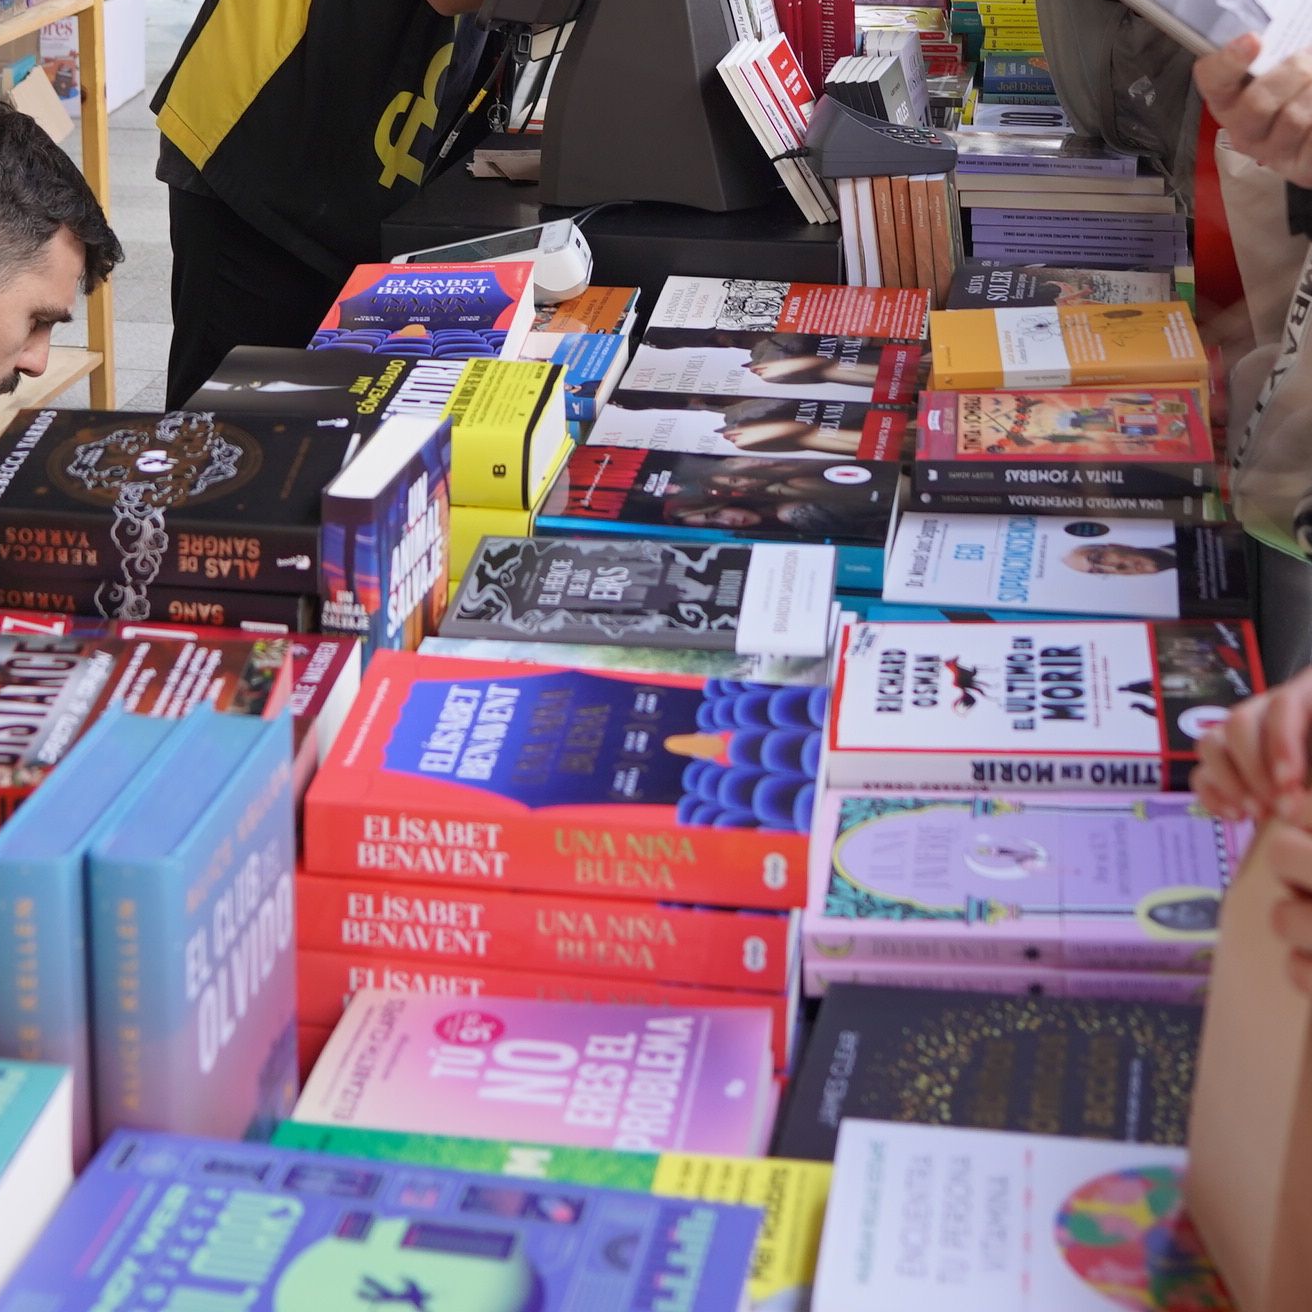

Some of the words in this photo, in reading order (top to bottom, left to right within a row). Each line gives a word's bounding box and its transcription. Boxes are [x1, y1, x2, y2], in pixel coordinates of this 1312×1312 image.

[376, 286, 491, 296] BENAVENT
[385, 277, 489, 288] ELÍSABET
[986, 270, 1014, 302] SOLER
[815, 337, 839, 359] JUAN
[841, 337, 863, 353] VAL
[838, 352, 859, 371] DEL
[348, 375, 374, 396] JUAN
[356, 359, 407, 415] GÓMEZ-JURADO
[794, 401, 819, 425] JUAN
[821, 402, 846, 420] VAL
[20, 409, 59, 454] YARROS
[816, 419, 840, 438] DEL
[1004, 468, 1070, 484] SOMBRAS
[1084, 469, 1125, 484] TINTA
[1008, 494, 1084, 509] ENVENENADA
[1087, 496, 1138, 510] NAVIDAD
[1138, 498, 1165, 511] UNA
[5, 526, 90, 548] YARROS
[176, 533, 261, 556] SANGRE
[178, 554, 199, 573] DE
[952, 542, 986, 563] EGO
[204, 555, 261, 579] ALAS
[322, 599, 368, 615] ANIMAL
[321, 612, 371, 631] SALVAJE
[1012, 635, 1034, 653] EN
[874, 646, 909, 715] RICHARD
[911, 654, 942, 709] OSMAN
[1040, 644, 1087, 723] MORIR
[455, 682, 522, 781] BENAVENT
[1012, 715, 1036, 733] EL
[971, 761, 1054, 785] MORIR
[1061, 763, 1083, 780] EN
[363, 814, 503, 849] ELÍSABET
[554, 827, 617, 858] UNA
[625, 831, 698, 865] NIÑA
[357, 843, 510, 879] BENAVENT
[575, 859, 676, 890] BUENA
[347, 892, 486, 928] ELÍSABET
[341, 918, 492, 956] BENAVENT
[536, 910, 604, 938] UNA
[605, 911, 678, 946] NIÑA
[556, 936, 657, 971] BUENA
[585, 1032, 638, 1062] EL
[477, 1038, 580, 1106] NO
[612, 1015, 696, 1152] PROBLEMA
[563, 1062, 627, 1128] ERES
